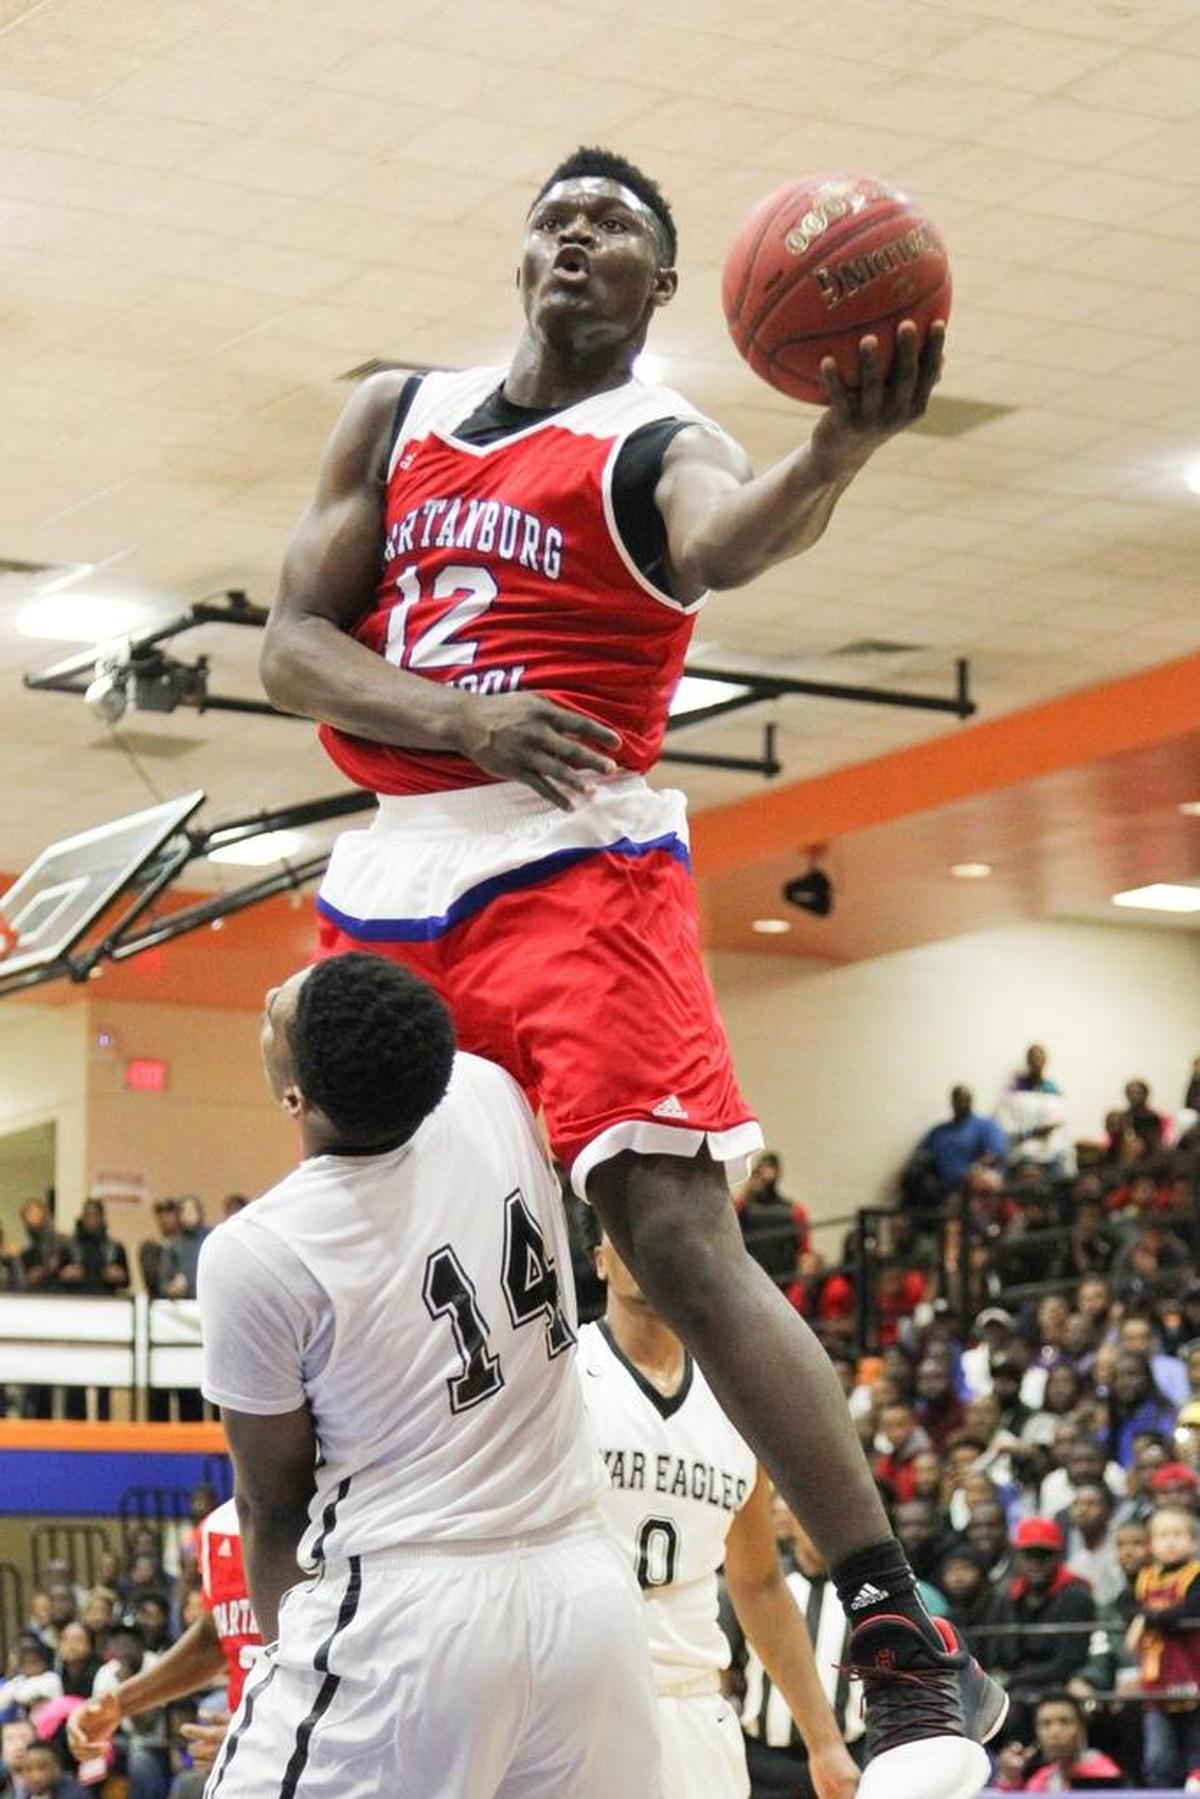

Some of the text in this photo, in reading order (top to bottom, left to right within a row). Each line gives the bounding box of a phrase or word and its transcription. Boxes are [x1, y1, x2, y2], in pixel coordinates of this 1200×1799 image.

[384, 565, 498, 668] 12
[421, 1186, 578, 1416] 14
[655, 1454, 747, 1511] EAGLES
[634, 1513, 681, 1591] 0
